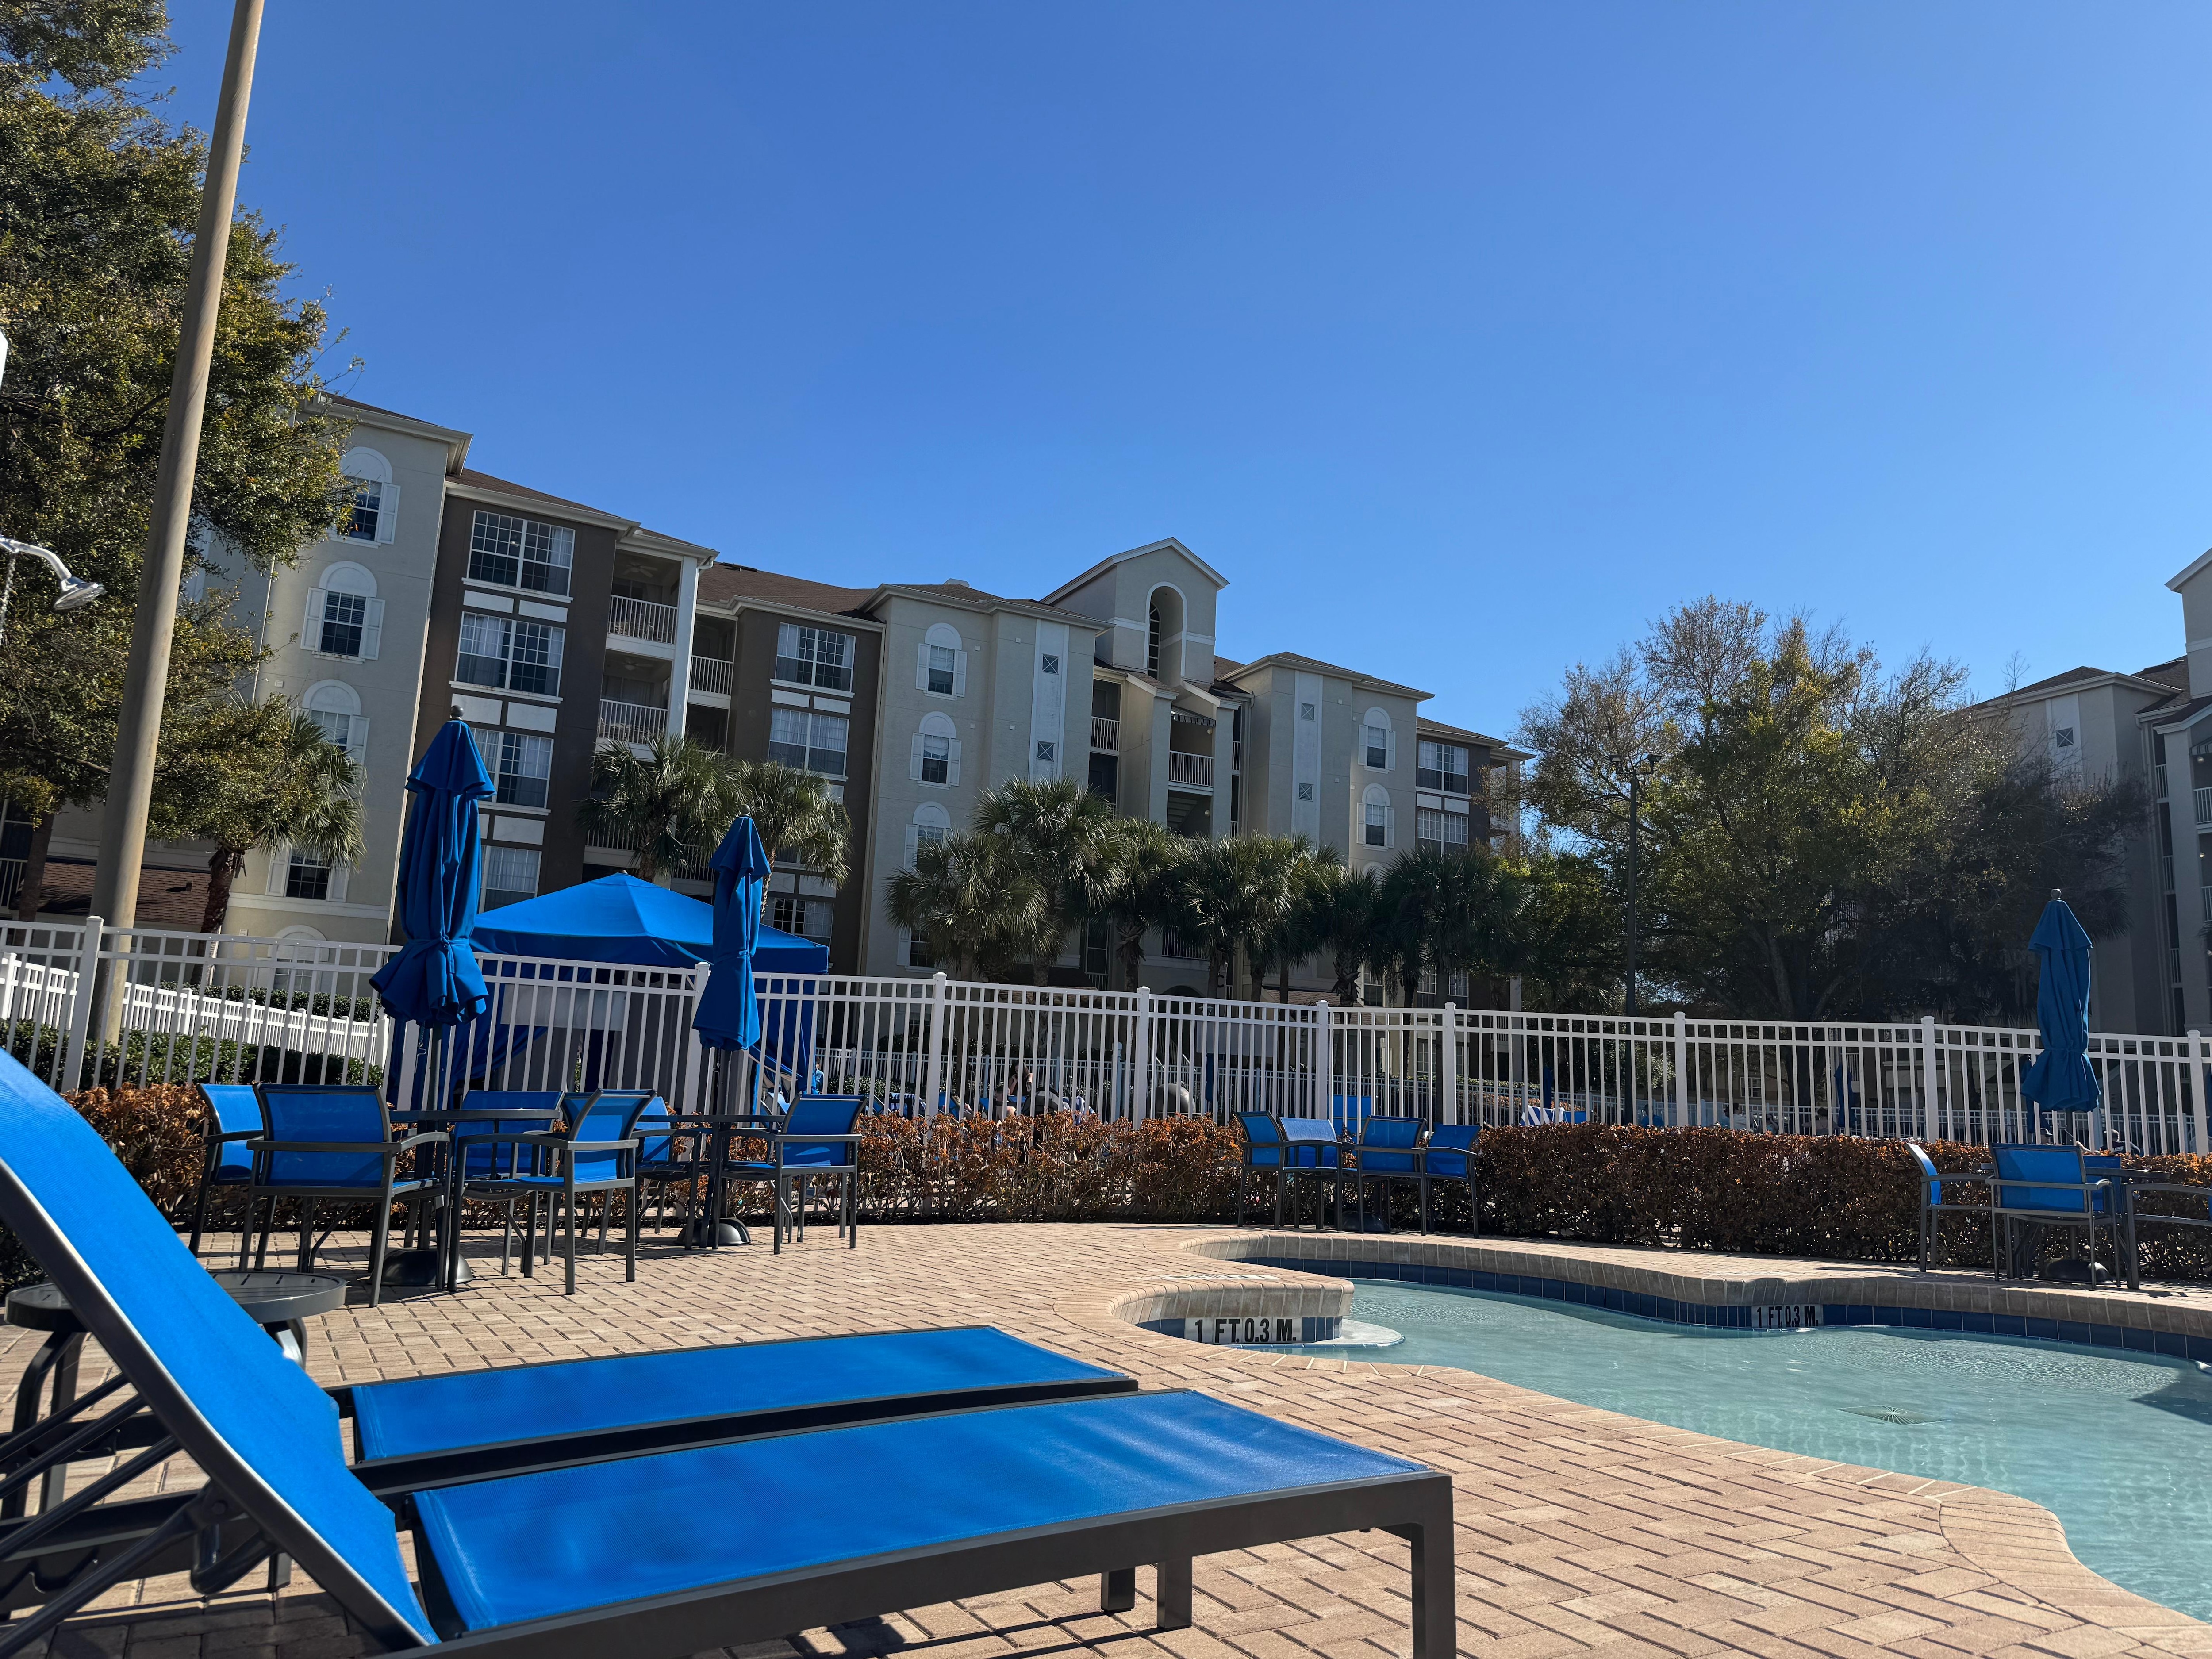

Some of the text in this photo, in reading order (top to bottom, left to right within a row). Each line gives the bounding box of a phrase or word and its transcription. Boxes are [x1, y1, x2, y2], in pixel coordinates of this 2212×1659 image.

[1757, 1306, 1818, 1328] 1 FT. 0.3 M.
[1195, 1318, 1296, 1343] 1 FT. 0.3 M.
